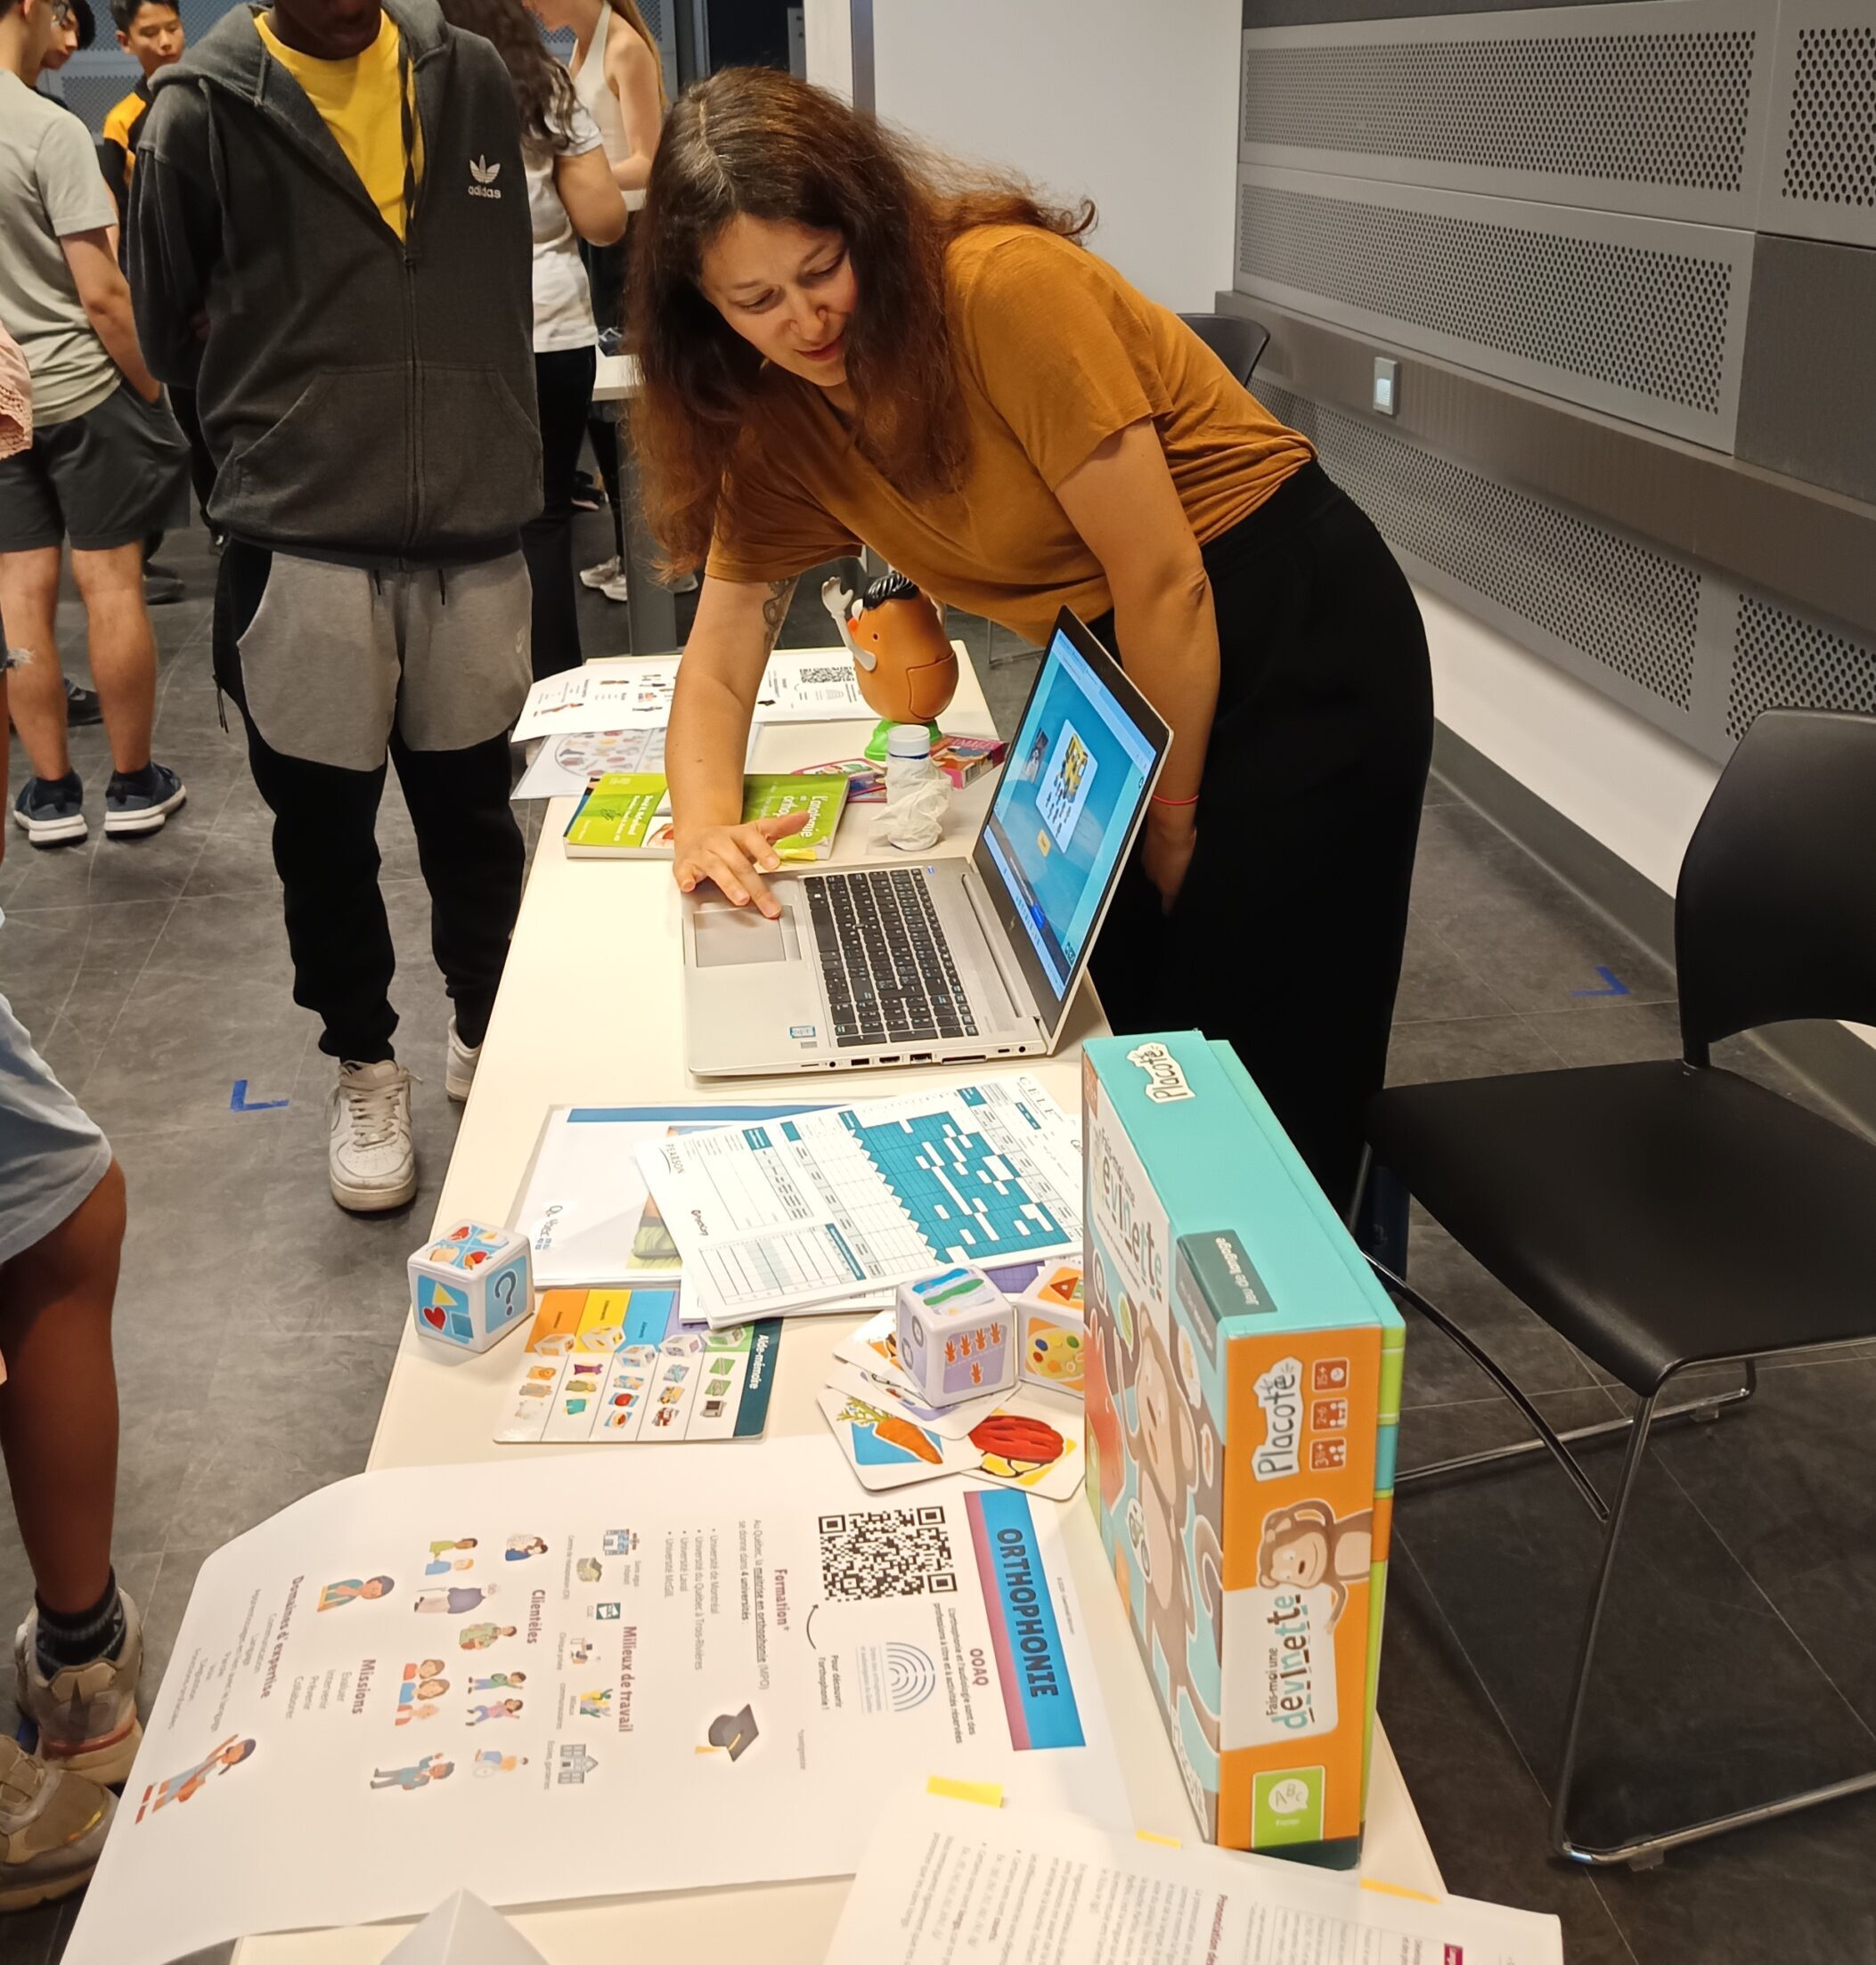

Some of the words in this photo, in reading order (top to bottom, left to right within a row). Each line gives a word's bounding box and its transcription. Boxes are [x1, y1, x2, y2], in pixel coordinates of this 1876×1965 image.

[468, 185, 502, 199] adidas
[772, 795, 795, 818] orthop
[526, 1589, 546, 1644] Clientèles
[997, 1528, 1059, 1698] ORTHOPHONIE
[260, 1642, 284, 1699] expertise
[622, 1627, 638, 1671] Milieux
[969, 1648, 990, 1687] OOAQ
[352, 1659, 377, 1715] Missions
[621, 1673, 635, 1688] de
[618, 1691, 634, 1733] travail
